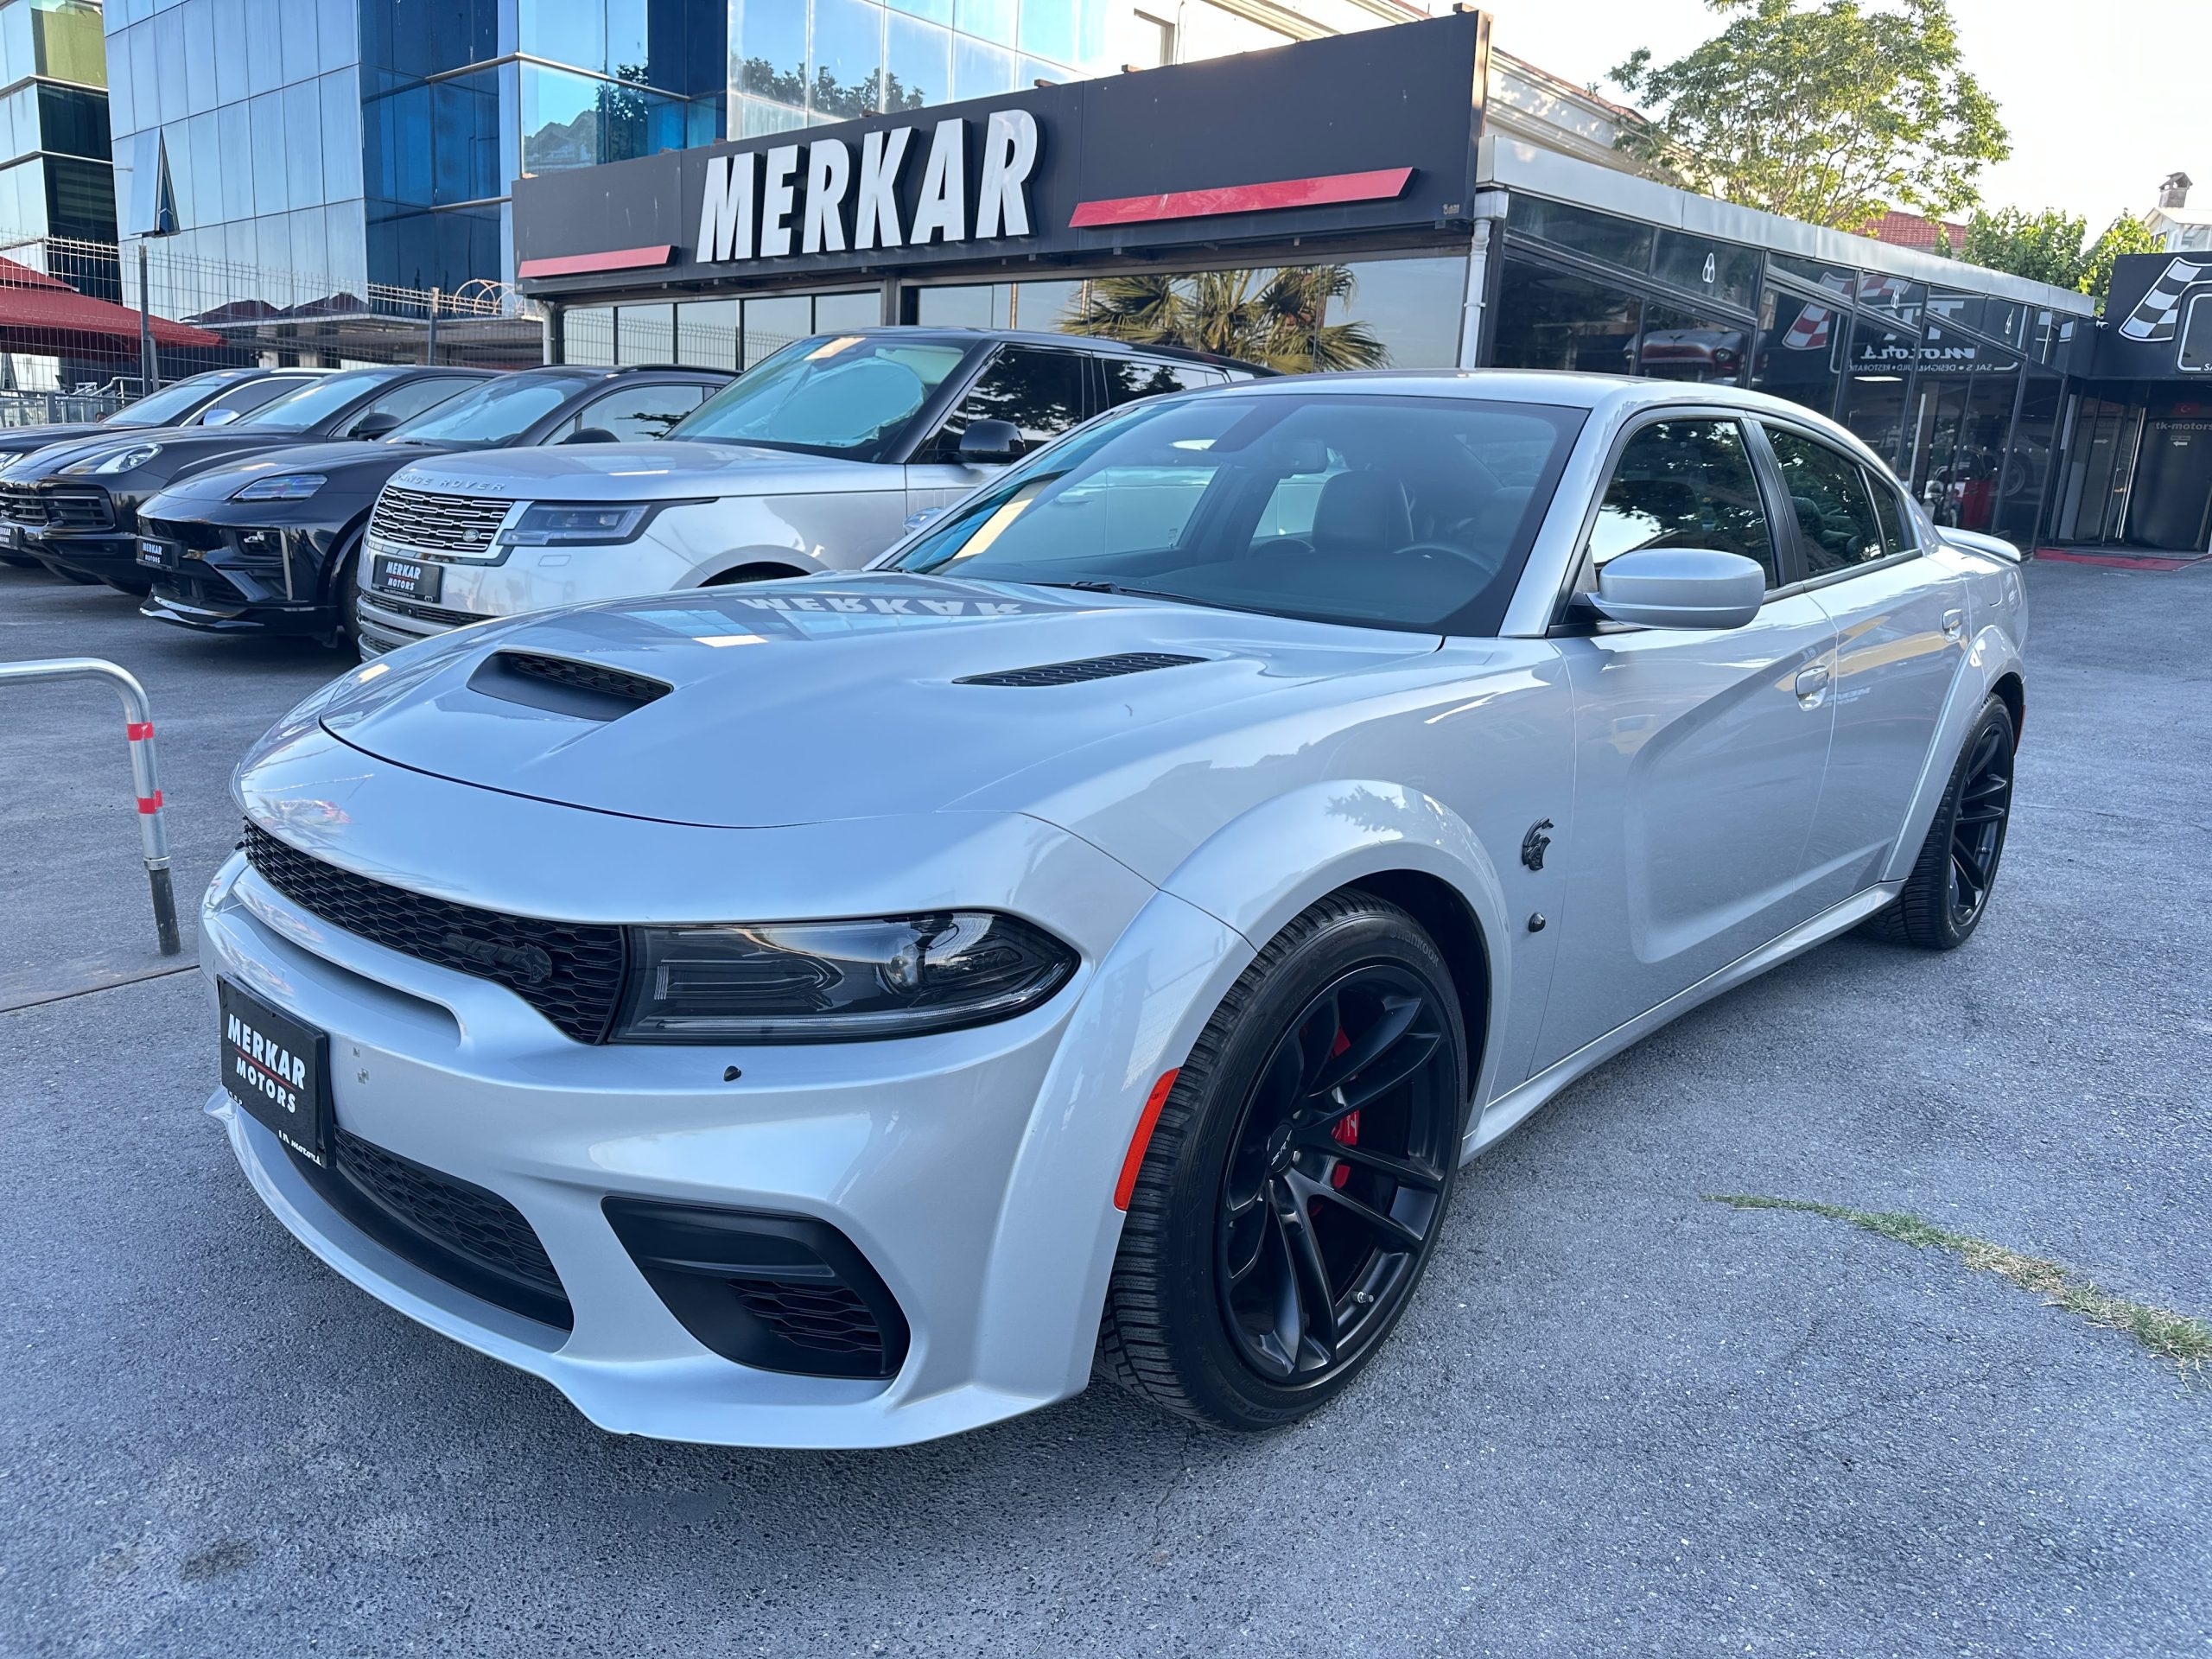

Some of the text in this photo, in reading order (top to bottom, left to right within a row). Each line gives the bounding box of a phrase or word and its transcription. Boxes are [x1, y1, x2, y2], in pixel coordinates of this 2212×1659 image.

[696, 109, 1039, 263] MERKAR
[393, 473, 506, 491] RANGE ROVER
[143, 542, 162, 555] MERKAR
[144, 554, 161, 563] MOTORS
[385, 561, 422, 580] MERKAR
[387, 577, 415, 591] MOTORS
[227, 1013, 306, 1090] MERKAR
[236, 1056, 296, 1113] MOTORS
